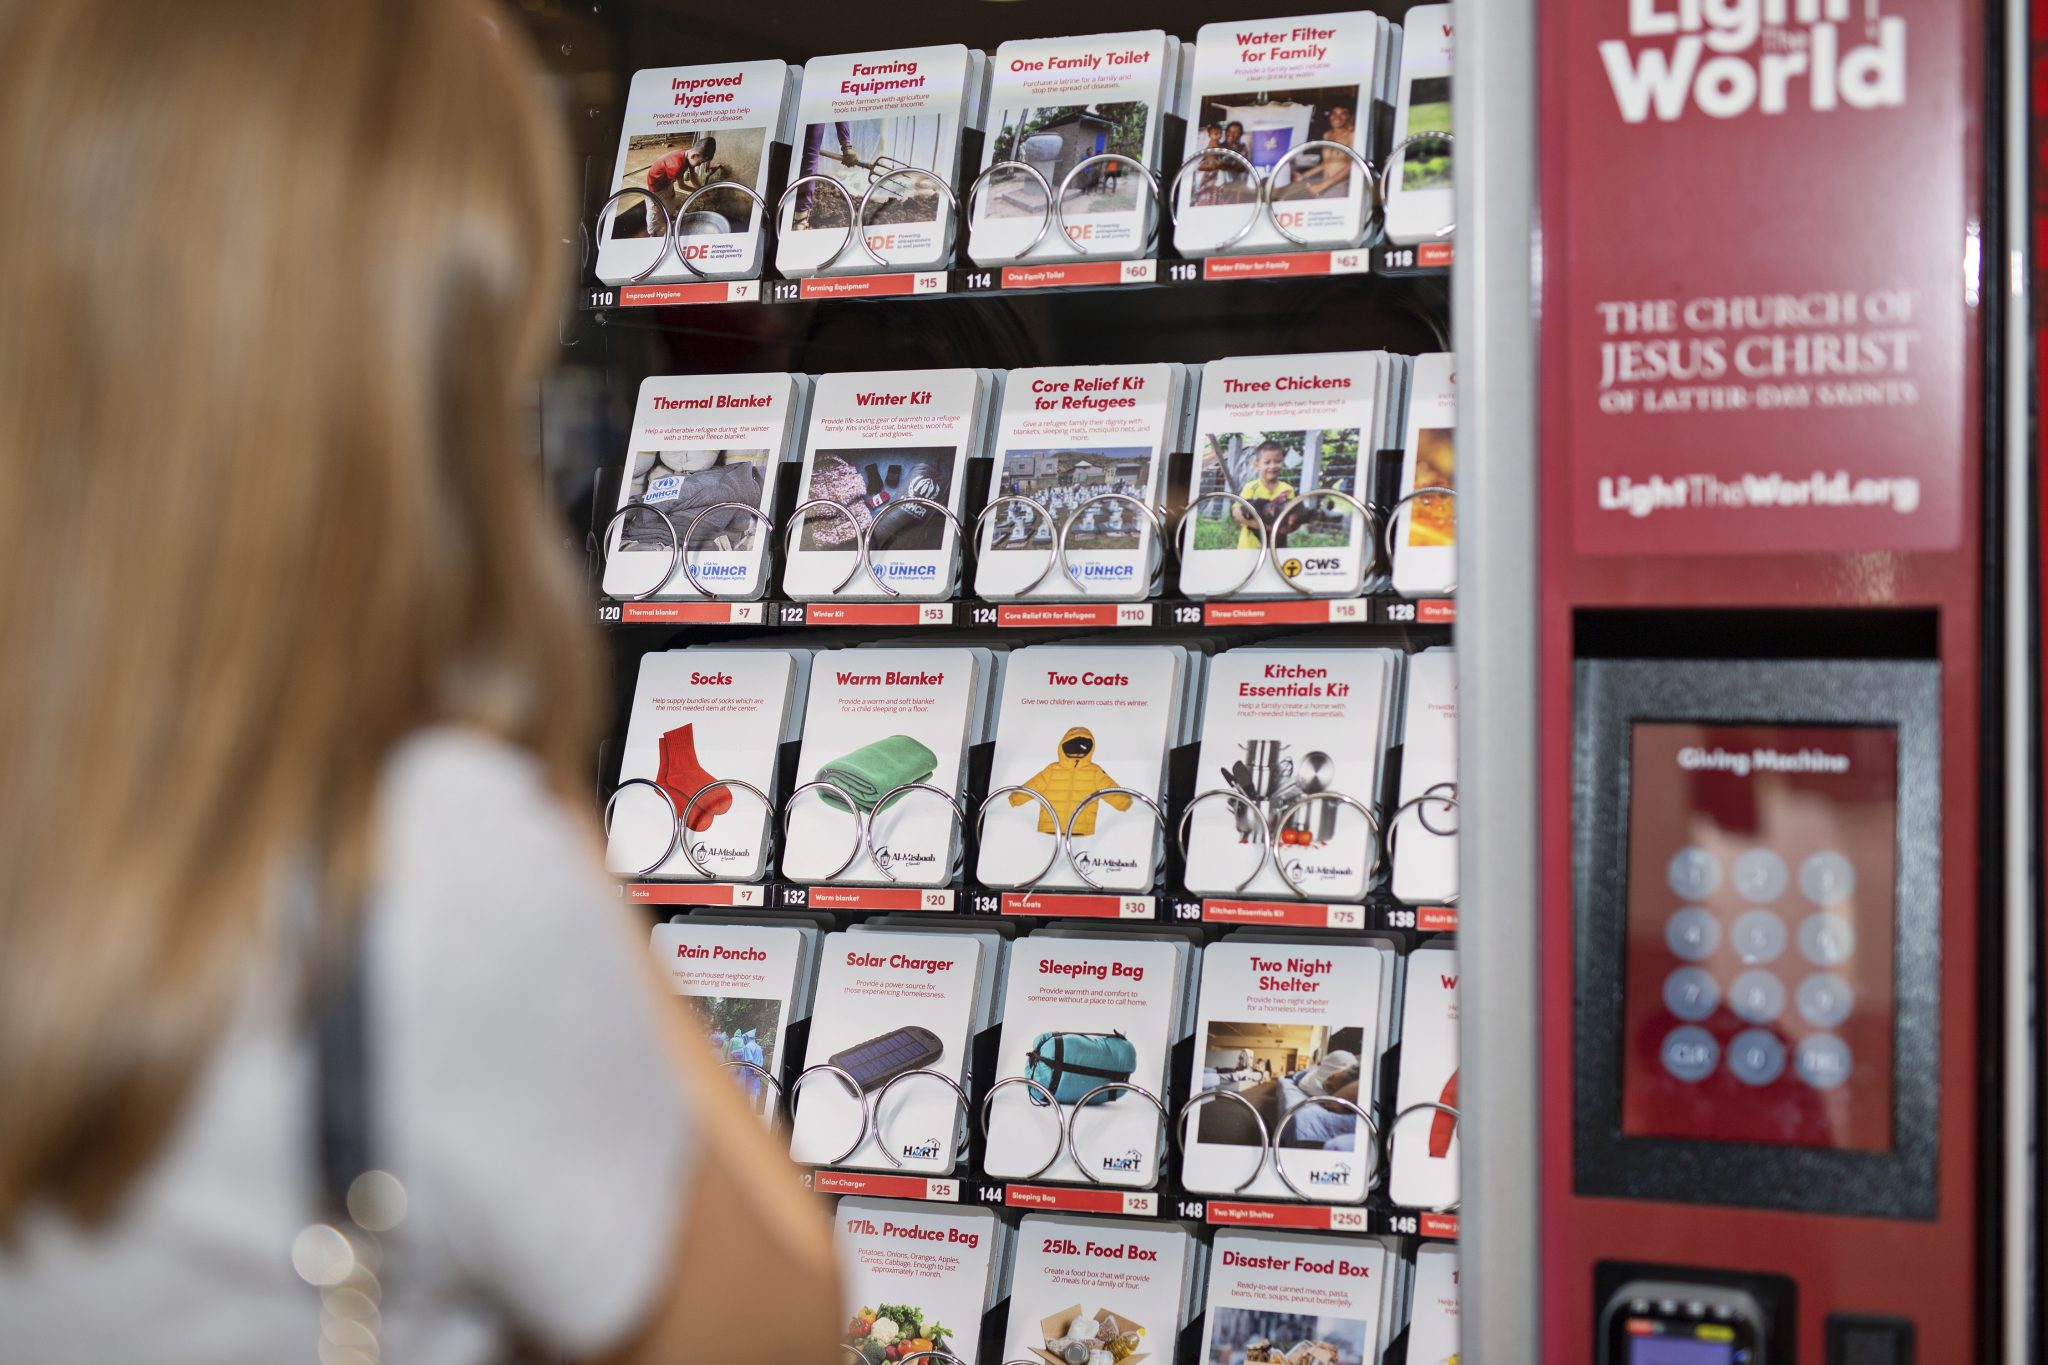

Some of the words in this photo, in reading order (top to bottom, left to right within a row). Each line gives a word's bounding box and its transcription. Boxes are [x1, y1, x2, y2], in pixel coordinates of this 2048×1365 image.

[1236, 32, 1287, 46] Water
[1292, 28, 1336, 41] Filter
[1242, 49, 1266, 62] for
[1270, 44, 1327, 61] Family
[1010, 60, 1044, 72] One
[1048, 54, 1102, 70] Family
[1106, 51, 1150, 65] Toilet
[853, 60, 918, 82] Farming
[1599, 16, 1906, 123] World
[672, 73, 743, 96] Improved
[841, 75, 925, 96] Equipment
[674, 91, 734, 109] Hygiene
[1338, 256, 1358, 267] $62
[1385, 250, 1413, 267] 118
[1008, 273, 1024, 281] One
[1024, 272, 1046, 281] Family
[1126, 266, 1147, 277] $60
[1170, 264, 1196, 280] 116
[807, 284, 834, 292] Farming
[834, 283, 869, 292] Equipment
[920, 278, 937, 288] $15
[967, 273, 991, 288] 114
[626, 292, 655, 301] Improved
[736, 286, 748, 296] $7
[775, 285, 798, 299] 112
[592, 292, 613, 306] 110
[1598, 301, 1676, 333] THE
[1684, 293, 1858, 330] CHURCH
[1864, 290, 1919, 326] OF
[1599, 340, 1727, 388] JESUS
[1735, 331, 1920, 377] CHRIST
[1032, 380, 1070, 393] Core
[1074, 377, 1120, 392] Relief
[1122, 376, 1145, 390] Kit
[1224, 379, 1271, 393] Three
[1275, 376, 1351, 391] Chickens
[654, 395, 714, 410] Thermal
[716, 394, 772, 408] Blanket
[856, 393, 907, 406] Winter
[910, 391, 932, 405] Kit
[1035, 396, 1059, 410] for
[1062, 395, 1136, 412] Refugees
[1599, 388, 1638, 413] OF
[1644, 385, 1811, 412] LATTER-DAY
[1817, 381, 1920, 406] SAINTS
[644, 488, 681, 501] UNHCR
[889, 566, 936, 576] UNHCR
[1085, 566, 1133, 576] UNHCR
[1305, 558, 1340, 570] CWS
[702, 566, 747, 578] UNHCR
[599, 607, 620, 620] 120
[739, 608, 750, 618] $7
[781, 608, 803, 622] 122
[925, 609, 944, 620] $53
[973, 608, 999, 623] 124
[1064, 612, 1096, 620] Refugees
[1121, 610, 1145, 620] $110
[1175, 607, 1201, 623] 126
[1337, 605, 1356, 616] $18
[1387, 604, 1415, 621] 128
[1265, 664, 1327, 678] Kitchen
[691, 672, 732, 685] Socks
[836, 672, 881, 685] Warm
[885, 672, 944, 685] Blanket
[1048, 672, 1078, 686] Two
[1082, 672, 1128, 686] Coats
[1239, 683, 1321, 697] Essentials
[1326, 683, 1349, 697] Kit
[1678, 747, 1750, 776] Giving
[1752, 748, 1850, 773] Machine
[630, 890, 650, 898] Socks
[742, 891, 753, 901] $7
[783, 890, 806, 904] 132
[835, 894, 859, 902] blanket
[927, 895, 946, 906] $20
[974, 897, 998, 912] 134
[1126, 902, 1145, 913] $30
[1175, 904, 1200, 919] 136
[1334, 911, 1354, 923] $75
[1388, 911, 1415, 928] 138
[677, 944, 710, 959] Rain
[713, 946, 766, 961] Poncho
[847, 952, 887, 967] Solar
[890, 955, 954, 974] Charger
[1250, 957, 1282, 978] Two
[1287, 958, 1332, 979] Night
[1039, 960, 1108, 980] Sleeping
[1112, 962, 1144, 982] Bag
[1259, 976, 1320, 992] Shelter
[822, 1178, 838, 1186] Solar
[839, 1179, 866, 1189] Charger
[932, 1184, 950, 1196] $25
[979, 1187, 1002, 1202] 144
[1012, 1192, 1041, 1202] Sleeping
[1042, 1194, 1056, 1204] Bag
[1128, 1198, 1148, 1210] $25
[1178, 1202, 1203, 1218] 148
[1214, 1208, 1229, 1216] Two
[1228, 1209, 1248, 1219] Night
[1249, 1210, 1274, 1219] Shelter
[1331, 1212, 1362, 1225] $250
[1390, 1217, 1417, 1234] 146
[848, 1220, 878, 1235] 17lb.
[883, 1222, 945, 1242] Produce
[948, 1228, 979, 1249] Bag
[1042, 1239, 1081, 1256] 25lb.
[1086, 1242, 1124, 1259] Food
[1128, 1245, 1157, 1261] Box
[1223, 1251, 1291, 1270] Disaster
[1295, 1257, 1334, 1274] Food
[1339, 1261, 1369, 1277] Box
